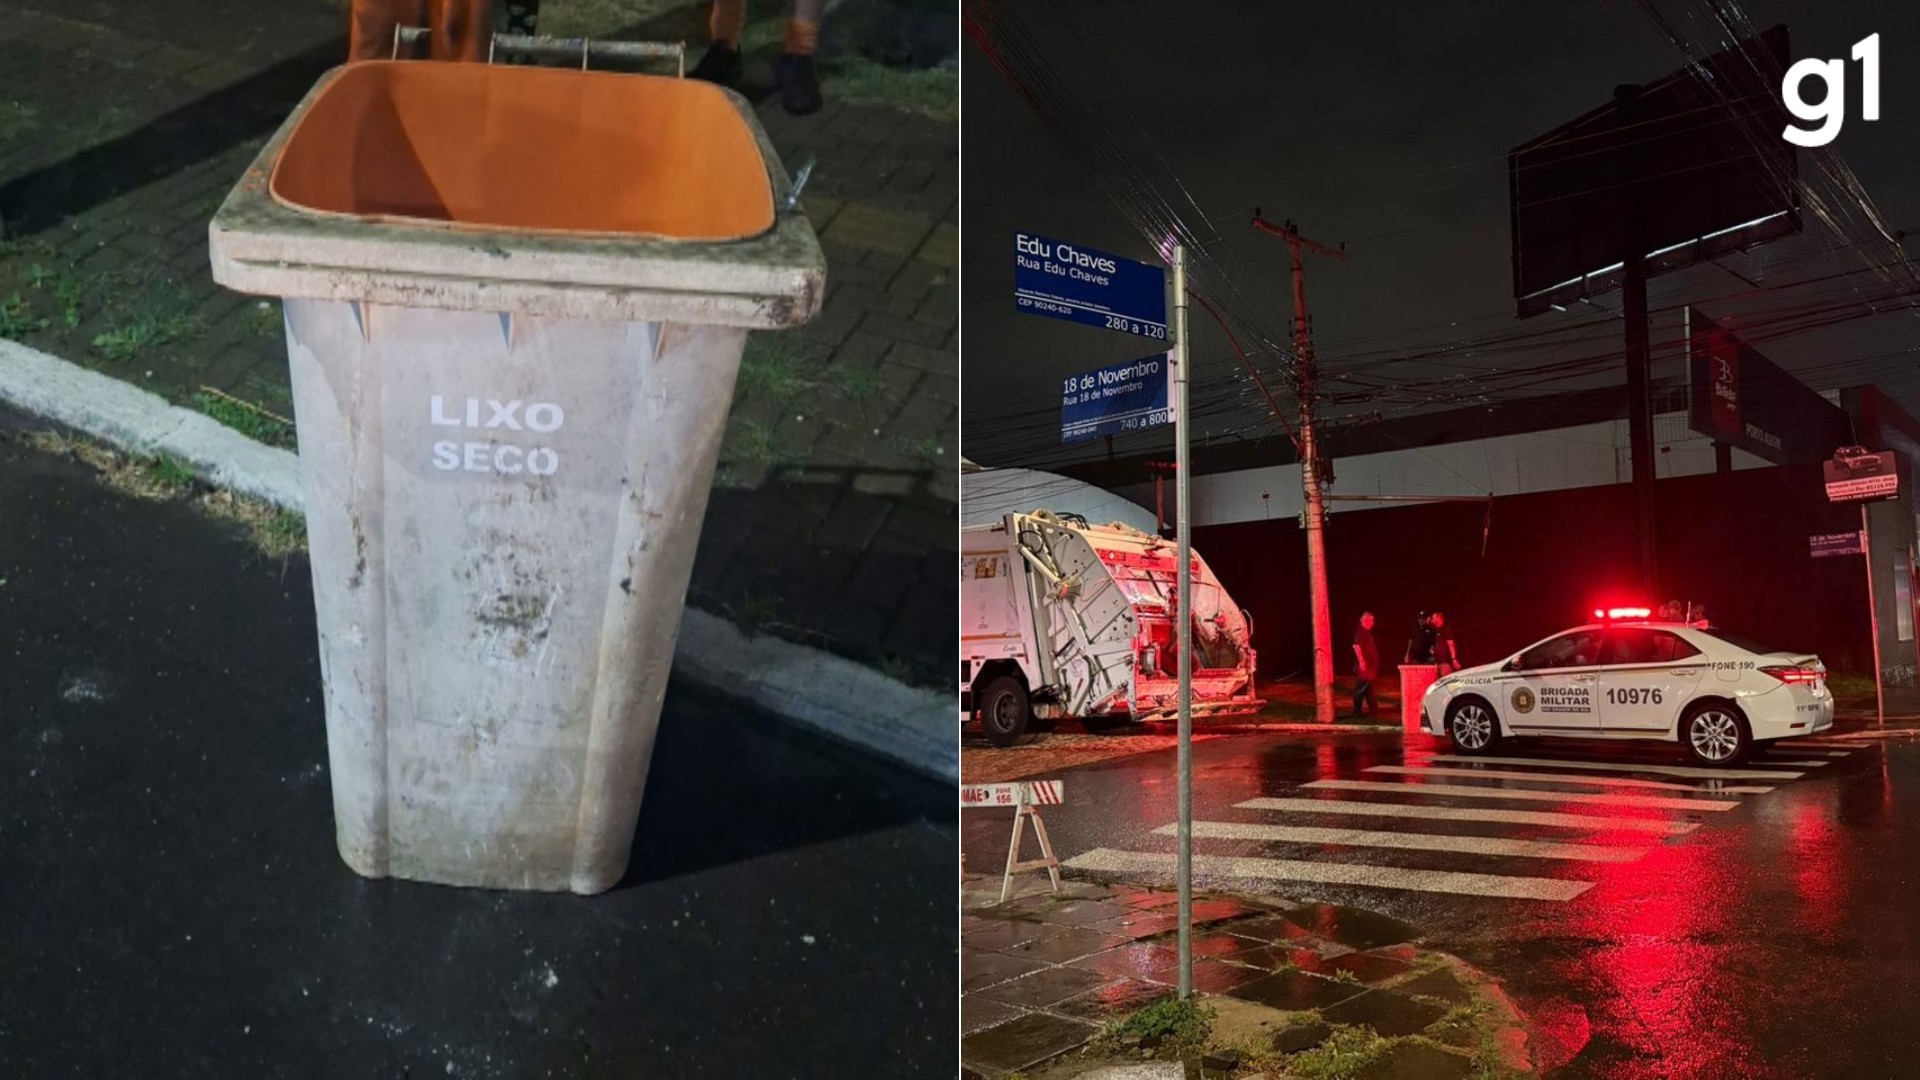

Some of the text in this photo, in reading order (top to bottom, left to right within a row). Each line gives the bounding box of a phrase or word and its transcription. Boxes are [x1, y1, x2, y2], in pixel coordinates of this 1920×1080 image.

[1016, 234, 1116, 274] Edu Chaves
[1017, 256, 1110, 286] Rua Edu Chaves
[1018, 298, 1033, 307] CEP
[1034, 301, 1072, 315] 90240-620
[1105, 315, 1165, 340] 280 a 120
[1063, 361, 1159, 394] 18 de Novembro
[1063, 381, 1144, 406] Rua 18 de Novembro
[431, 395, 564, 432] LIXO
[1120, 418, 1138, 431] 740
[1140, 418, 1147, 427] a
[1149, 411, 1167, 426] 800
[432, 439, 559, 475] SECO
[1711, 661, 1755, 670] FONE 190
[1540, 687, 1590, 696] BRIGADA
[1540, 696, 1590, 705] MILITAR
[1606, 688, 1663, 704] 10976
[961, 788, 983, 802] MAE
[996, 794, 1012, 803] 156
